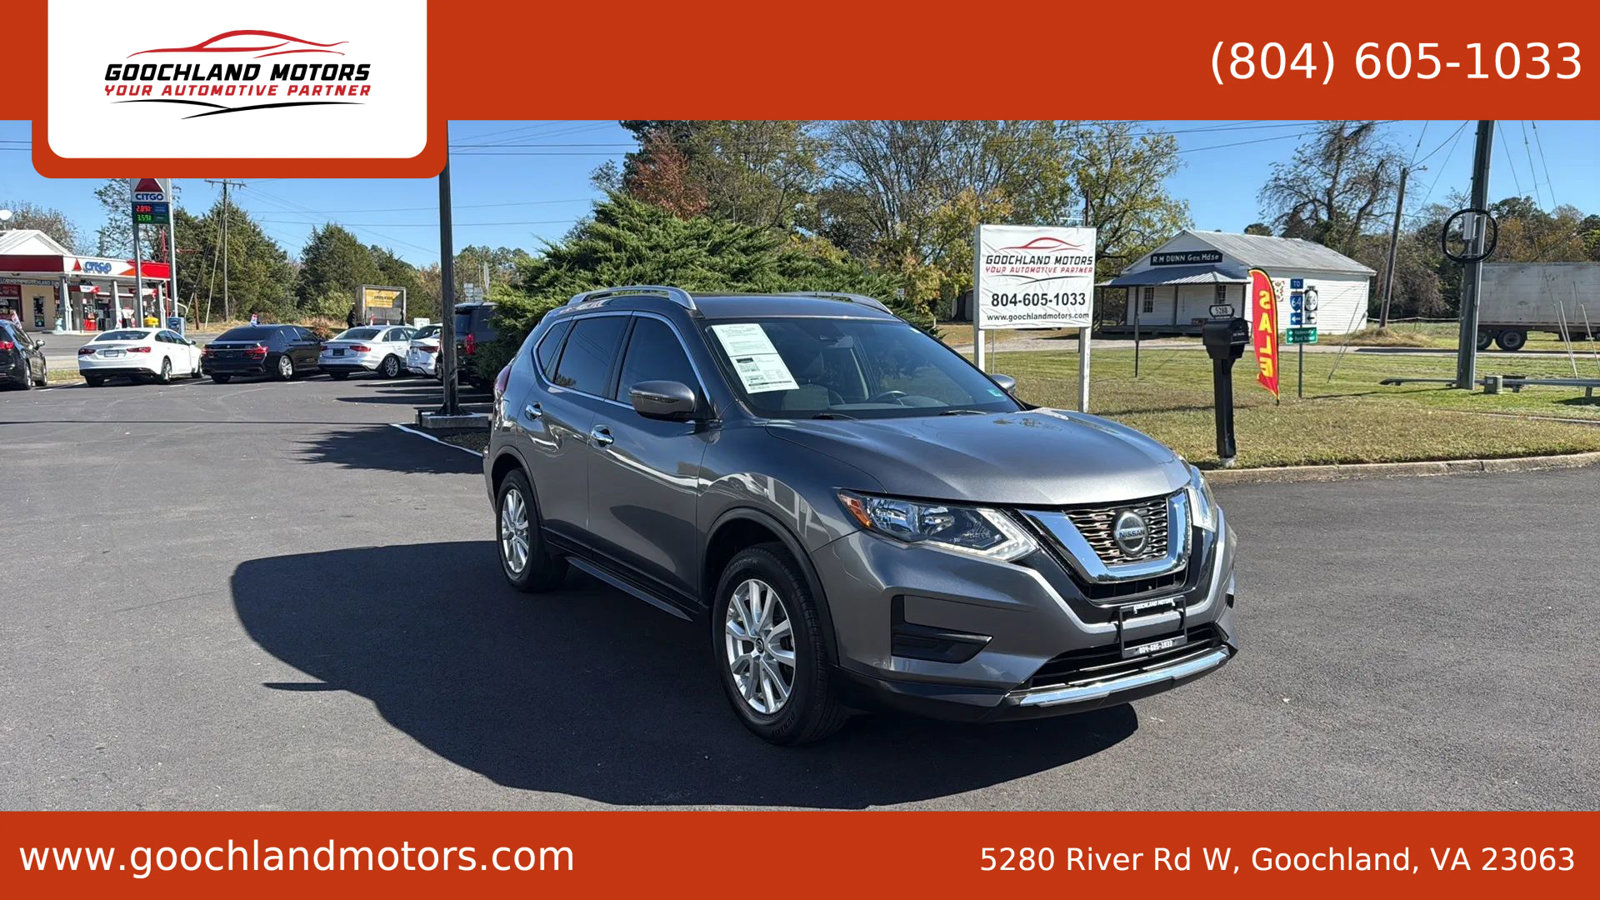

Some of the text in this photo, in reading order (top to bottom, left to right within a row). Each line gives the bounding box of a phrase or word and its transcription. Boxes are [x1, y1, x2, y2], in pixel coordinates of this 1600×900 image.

[135, 193, 164, 201] CITGO
[986, 255, 1093, 265] GOOCHLAND MOTORS
[1166, 254, 1186, 262] DUNN
[1201, 253, 1220, 261] Mdse
[83, 261, 112, 274] CITGO
[991, 292, 1086, 307] 804-605-1033
[1291, 297, 1302, 307] 64
[987, 312, 1089, 322] www.goochlandmotors.com
[1119, 529, 1145, 539] NISSAN
